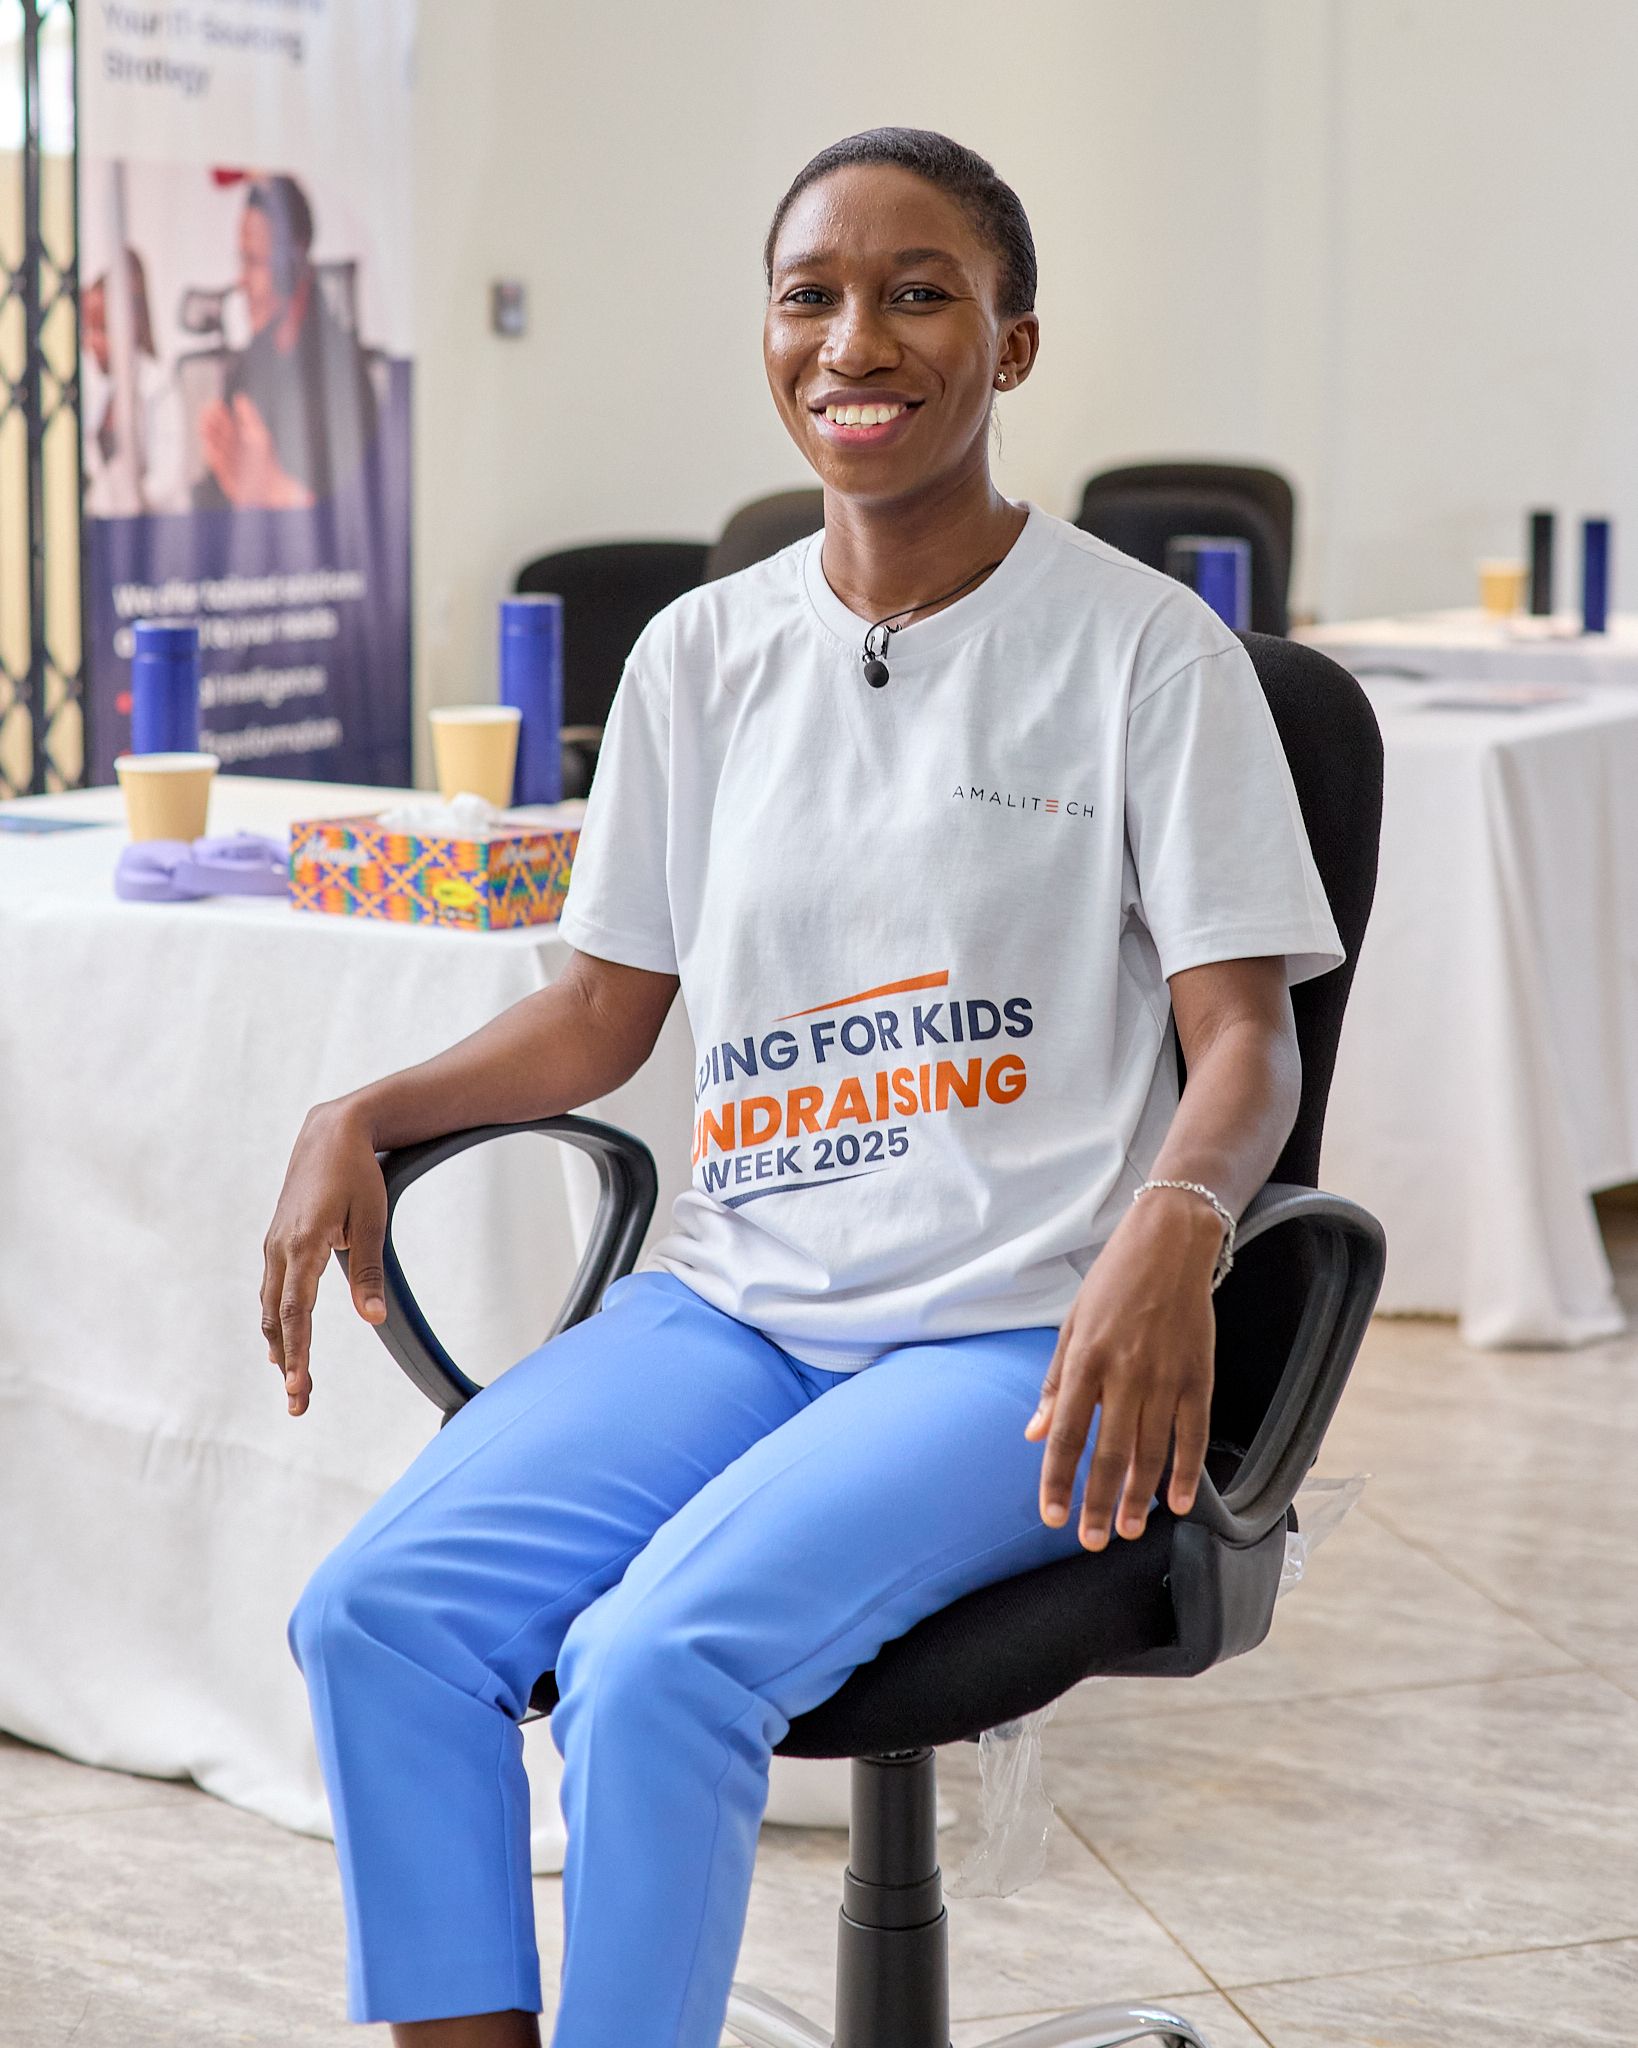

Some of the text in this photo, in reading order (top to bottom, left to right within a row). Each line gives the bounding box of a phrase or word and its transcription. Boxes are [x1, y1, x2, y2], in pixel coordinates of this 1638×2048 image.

[953, 785, 1094, 818] AMALITECH
[811, 1010, 902, 1063] FOR
[912, 997, 1034, 1047] KIDS
[702, 1126, 910, 1194] WEEK 2025
